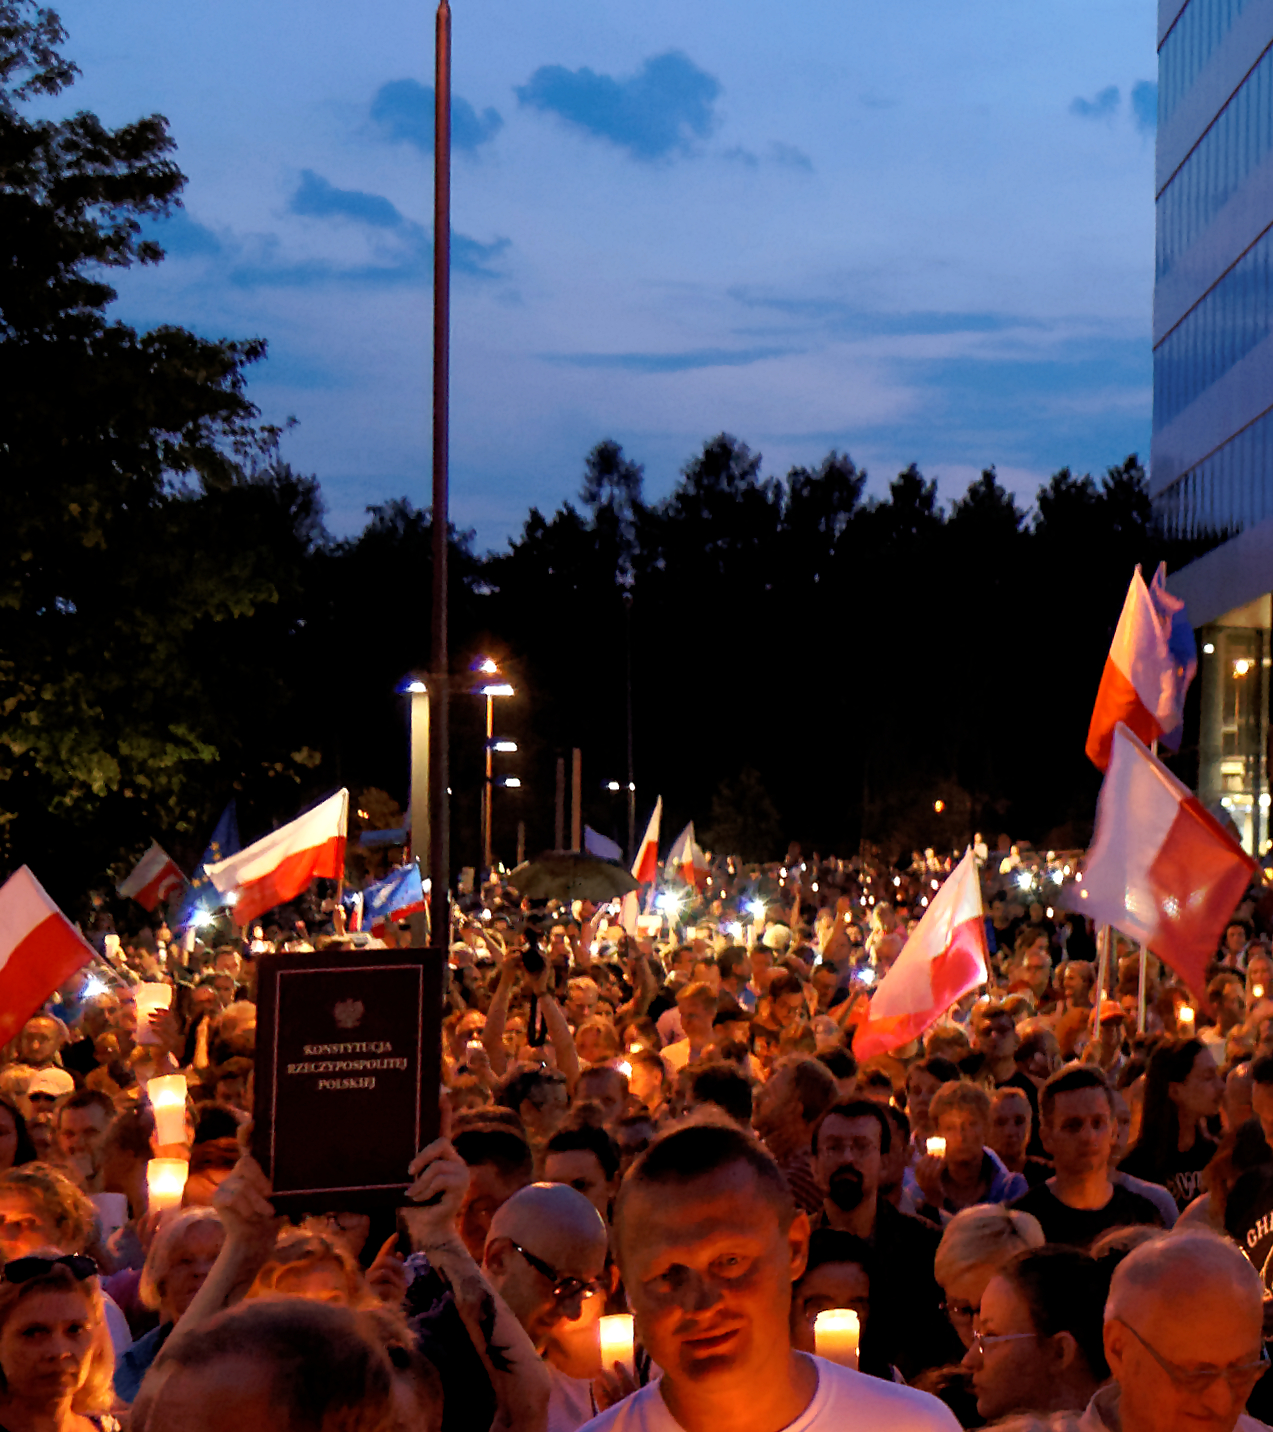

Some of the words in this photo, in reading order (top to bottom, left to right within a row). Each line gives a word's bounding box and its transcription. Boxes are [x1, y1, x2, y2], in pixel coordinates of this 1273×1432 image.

[303, 1041, 393, 1056] KONSTYTUCJA
[287, 1057, 408, 1074] RZECZYPOSPOLITEJ
[318, 1076, 376, 1090] POLSKIEJ
